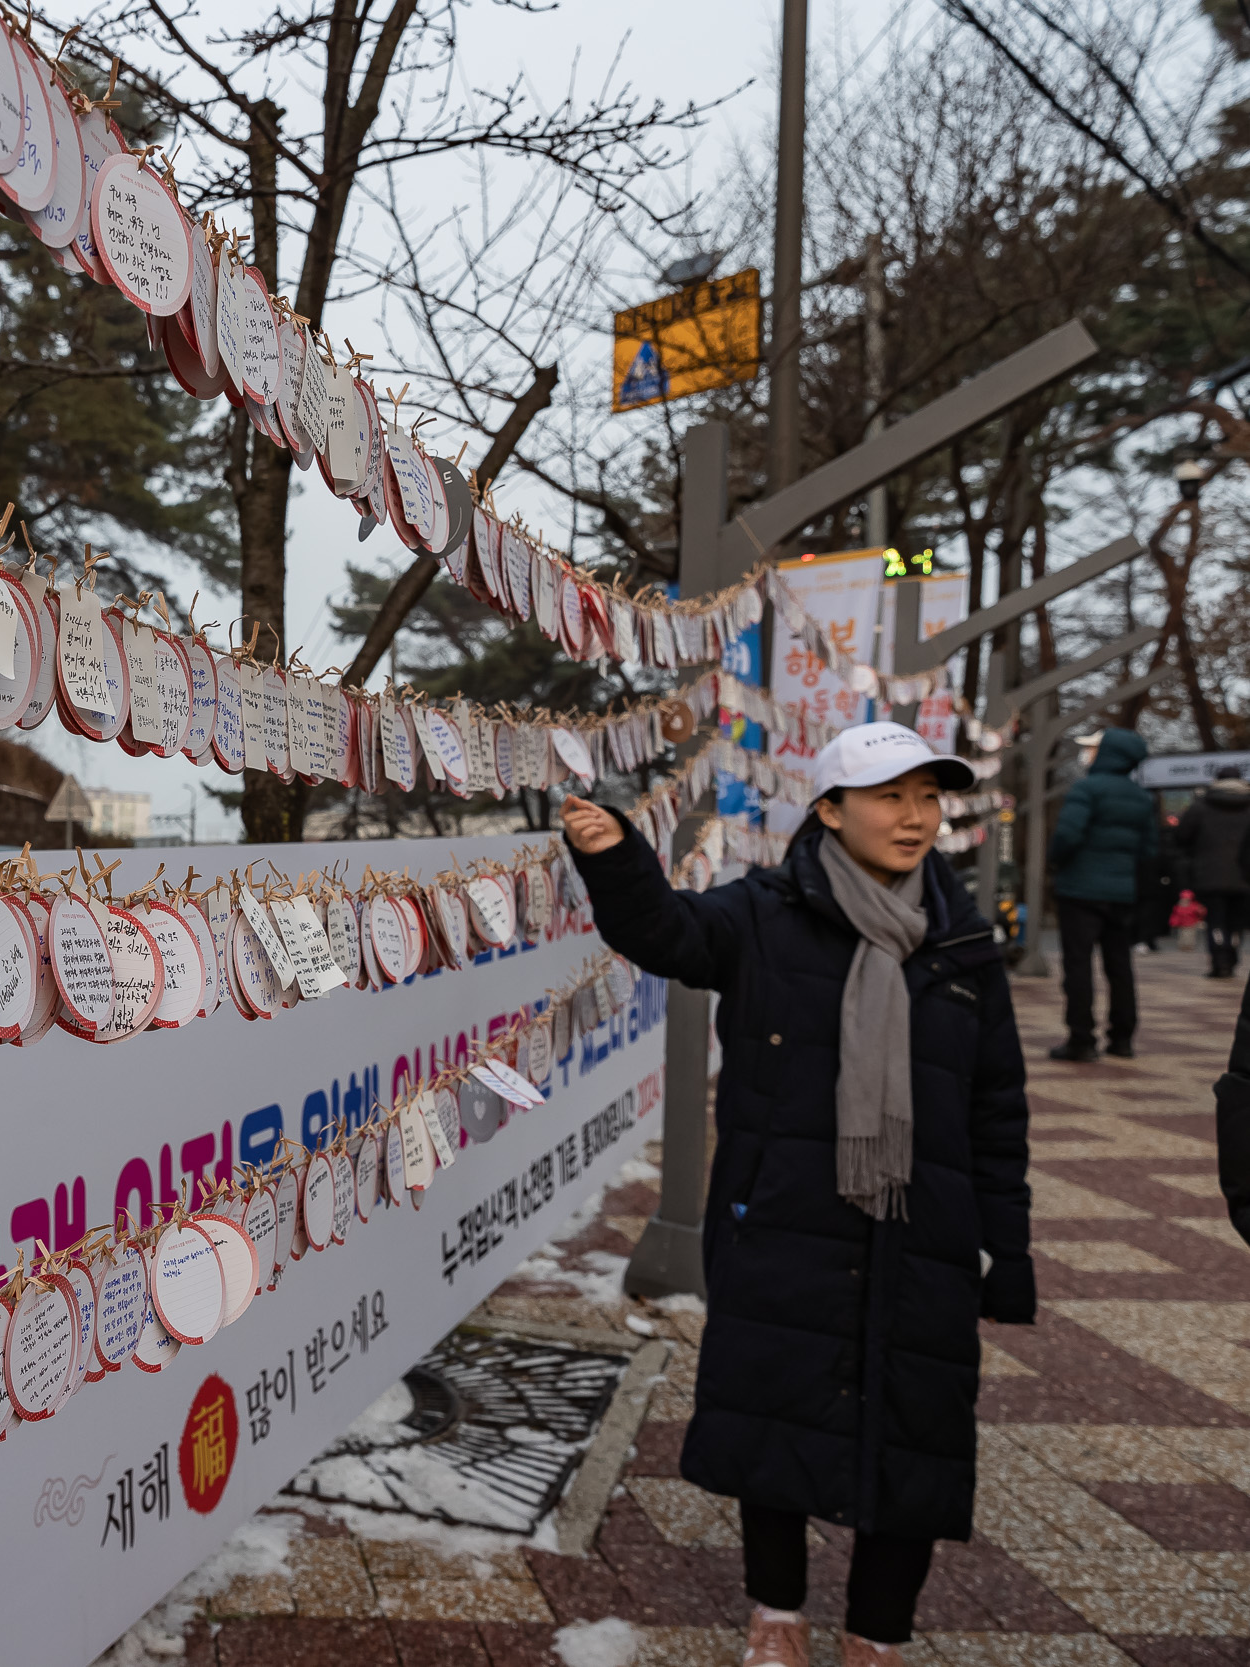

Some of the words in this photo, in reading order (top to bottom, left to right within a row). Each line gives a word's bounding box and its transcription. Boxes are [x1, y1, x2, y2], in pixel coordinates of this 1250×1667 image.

[65, 612, 91, 632] 2024년
[101, 1442, 171, 1551] 새해
[244, 1349, 296, 1446] 많이
[305, 1289, 390, 1394] 받으세요
